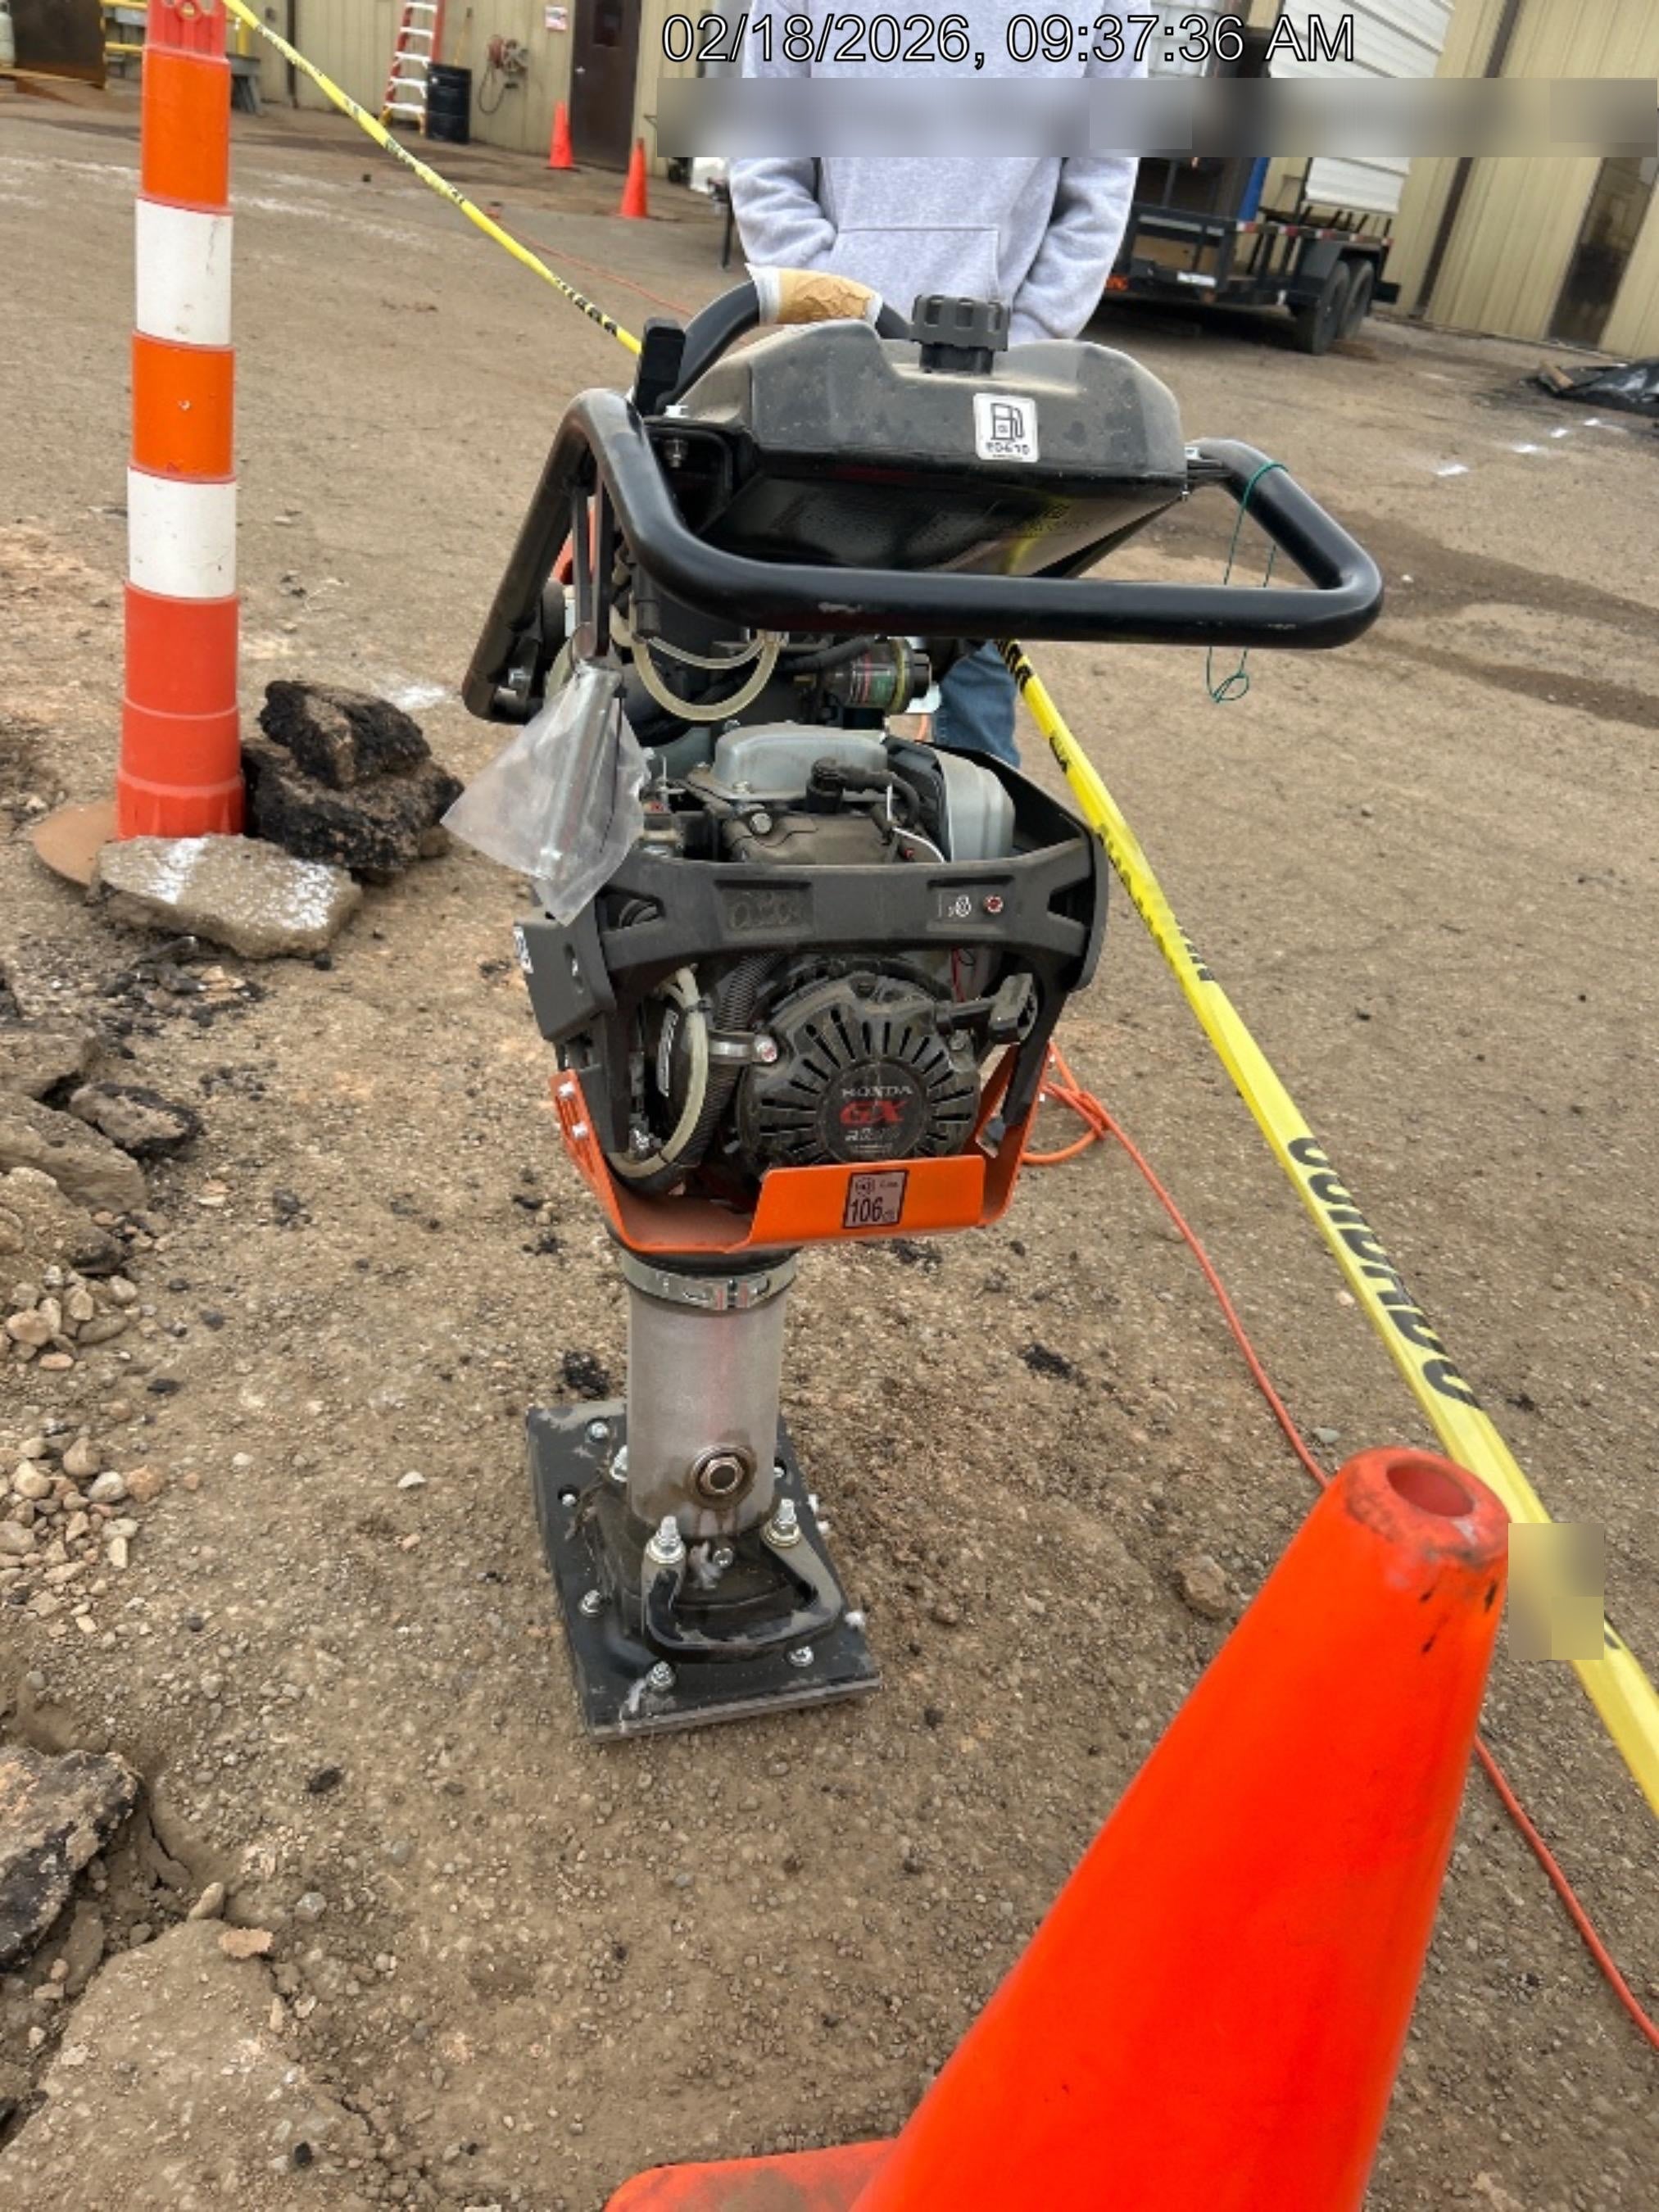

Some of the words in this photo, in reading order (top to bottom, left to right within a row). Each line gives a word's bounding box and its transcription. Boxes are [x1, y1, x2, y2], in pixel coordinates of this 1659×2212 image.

[841, 1086, 913, 1097] HONDA
[840, 1100, 908, 1124] GX
[850, 1196, 883, 1223] 106
